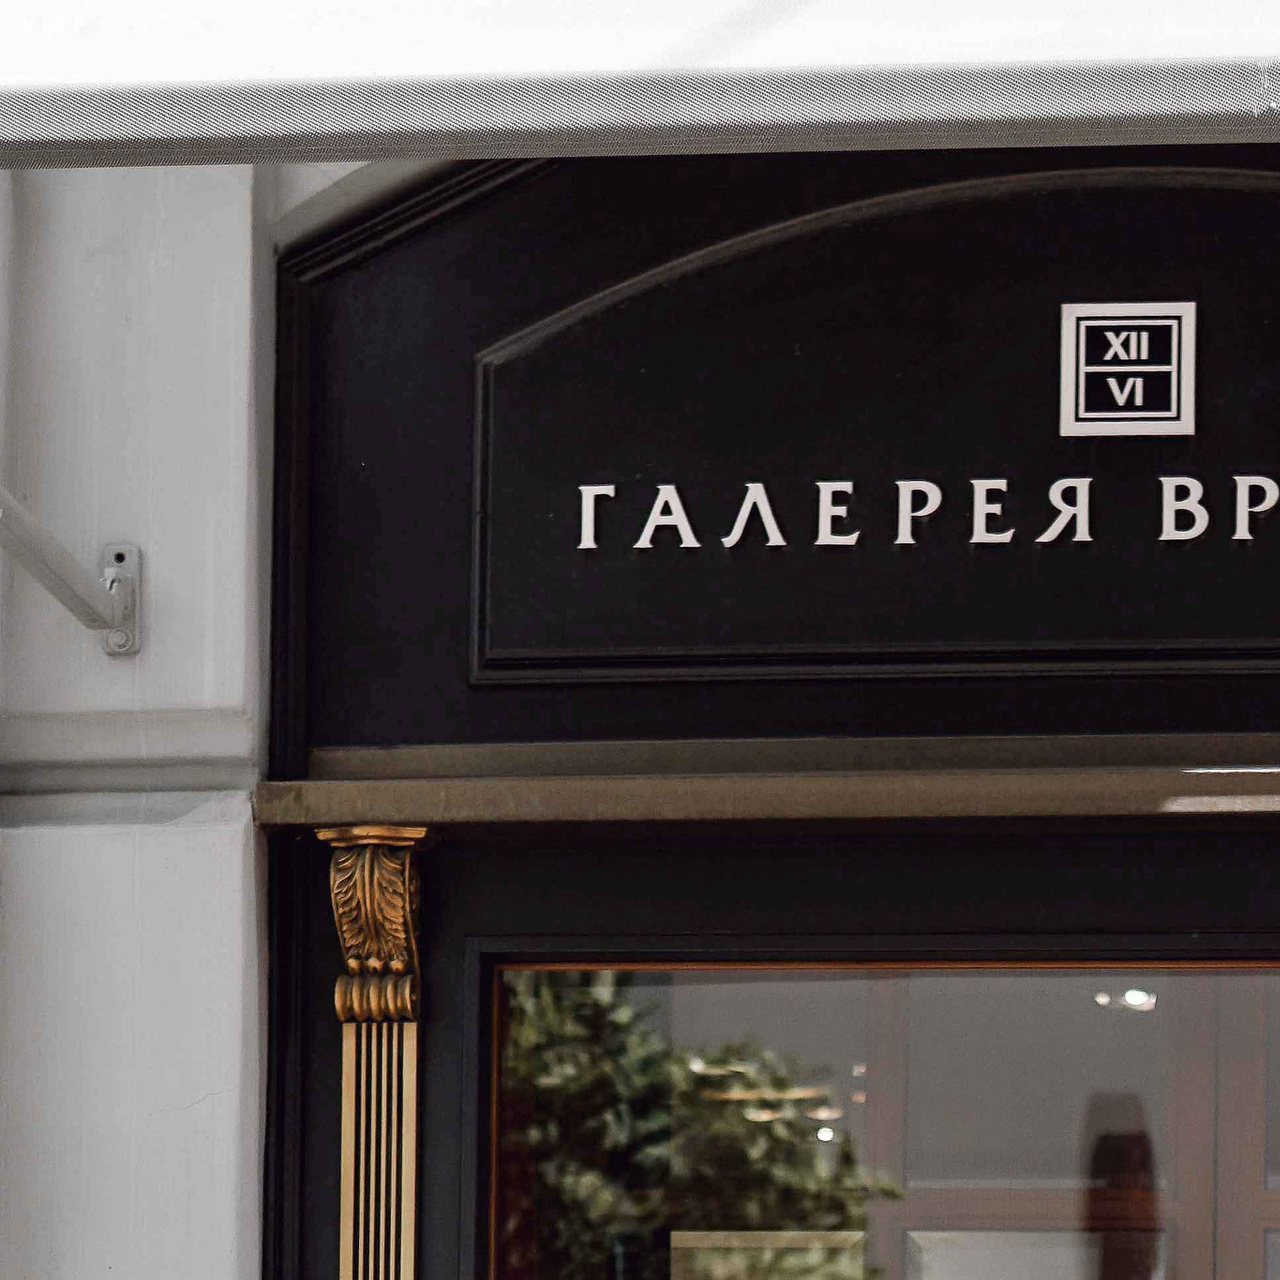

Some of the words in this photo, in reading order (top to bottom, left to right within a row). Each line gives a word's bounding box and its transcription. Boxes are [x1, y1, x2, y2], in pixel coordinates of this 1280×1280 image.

[1103, 331, 1149, 361] XII
[1106, 377, 1144, 407] VI
[577, 477, 1094, 549] ГАЛЕРЕЯ
